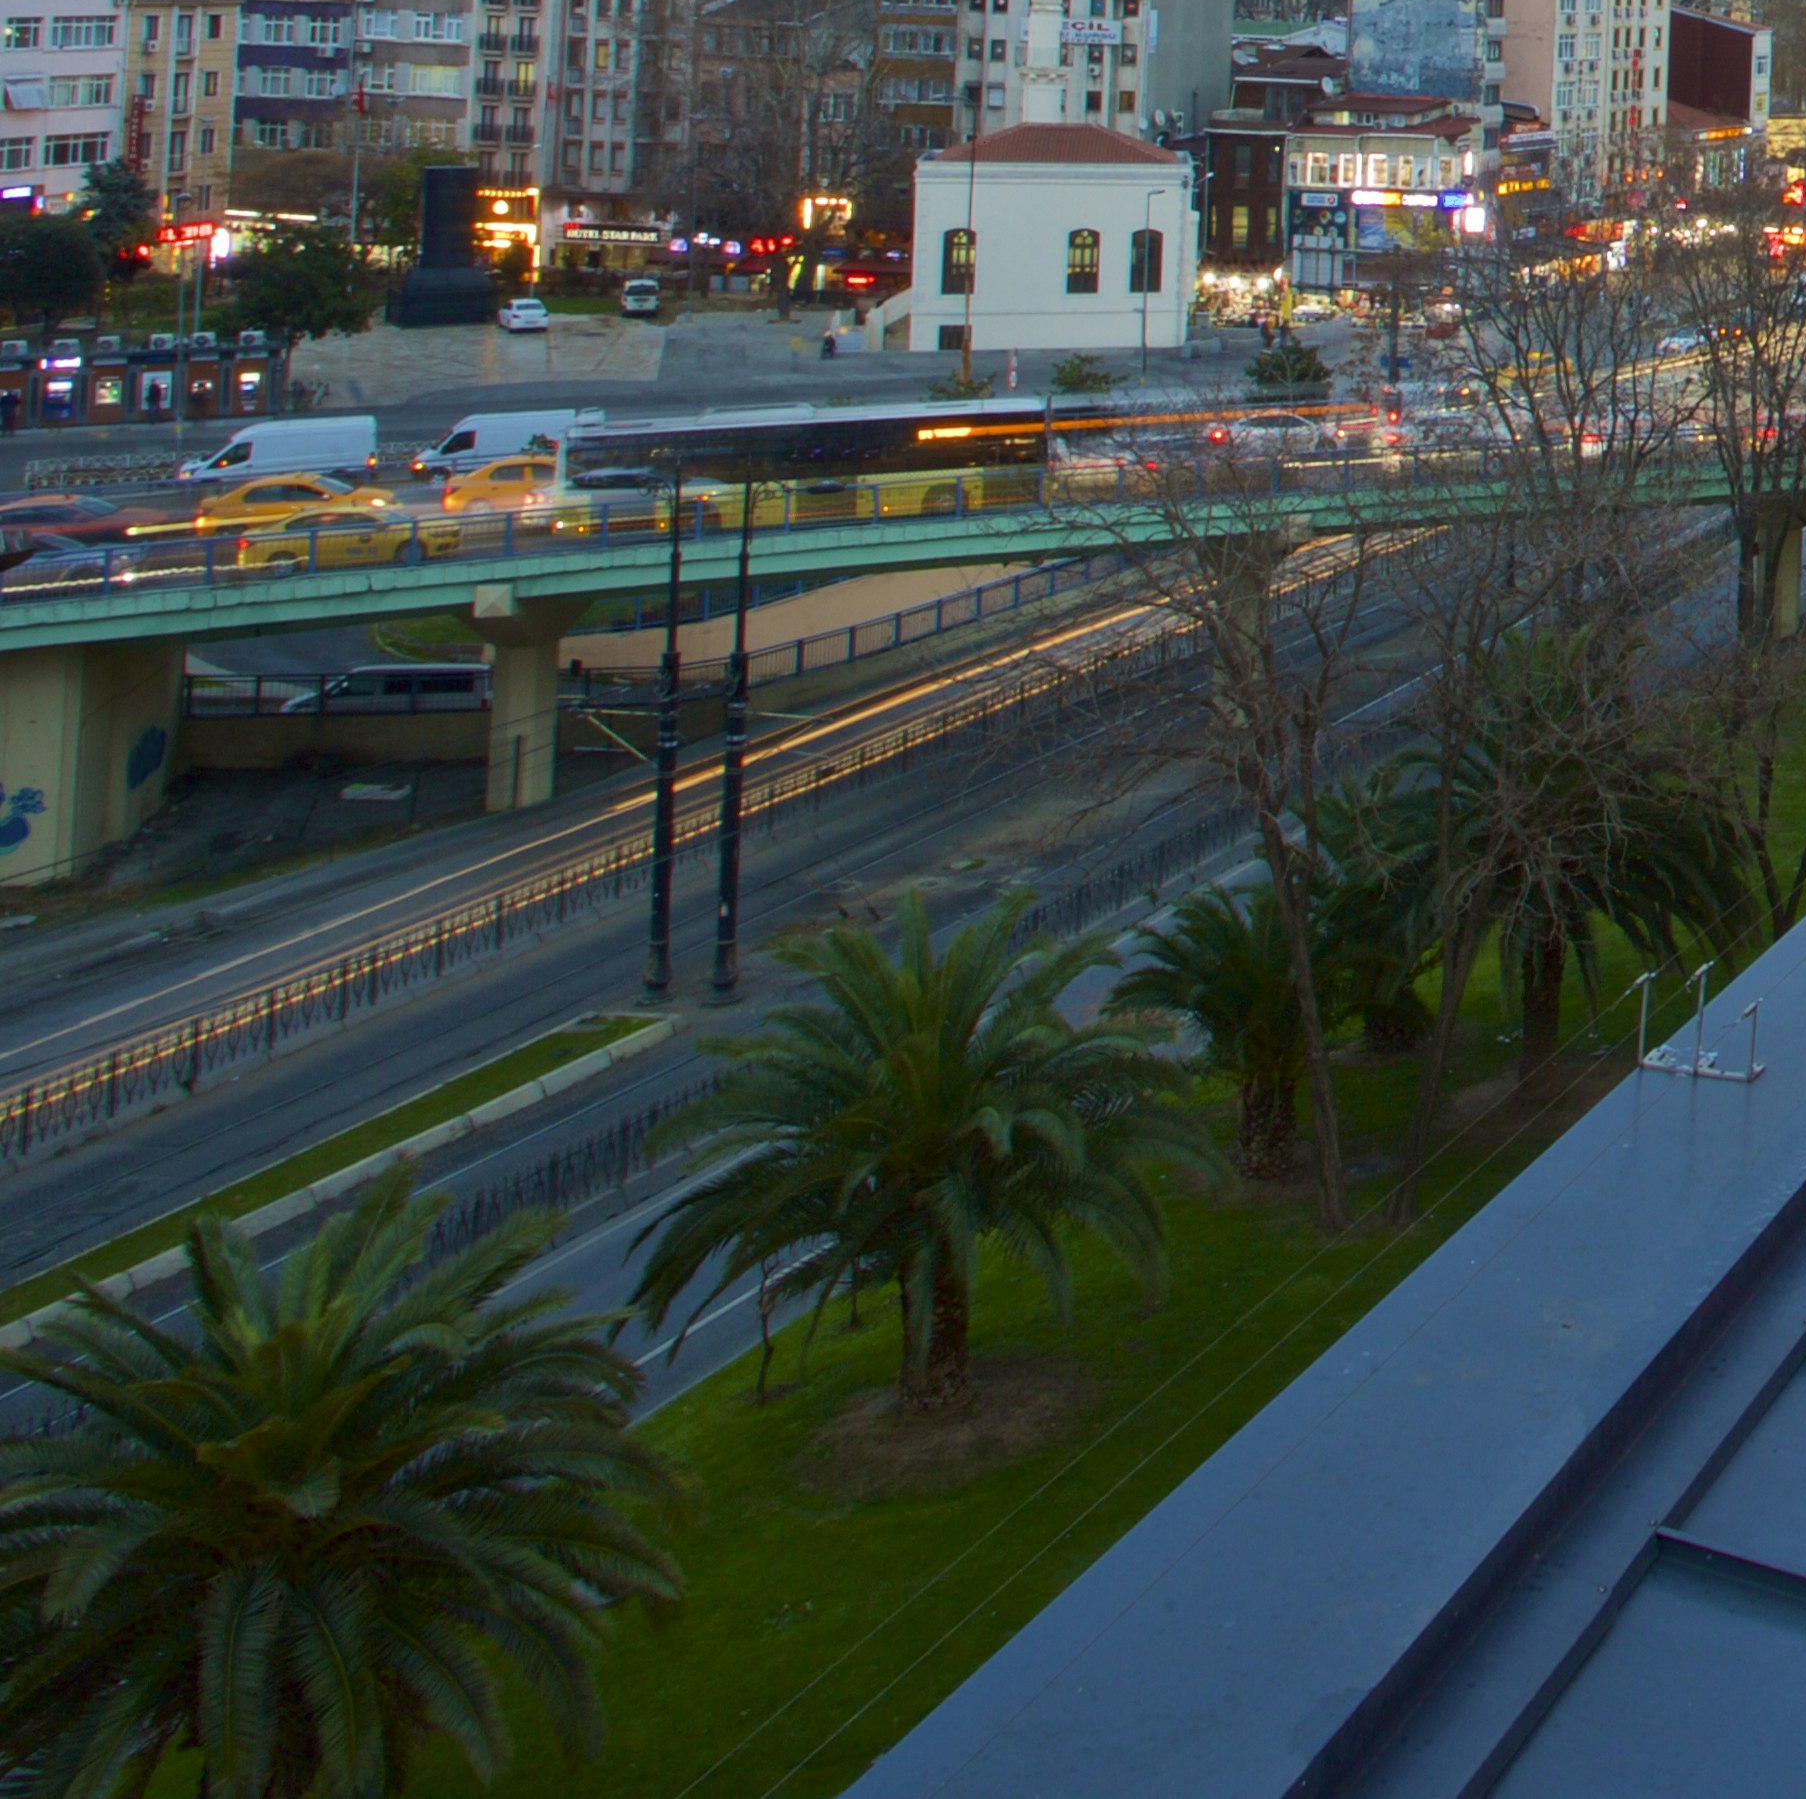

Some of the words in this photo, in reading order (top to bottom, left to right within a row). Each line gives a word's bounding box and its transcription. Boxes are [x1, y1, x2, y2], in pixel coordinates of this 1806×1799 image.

[566, 228, 600, 239] HOTEL
[602, 229, 629, 240] STAR
[630, 231, 658, 242] PARK
